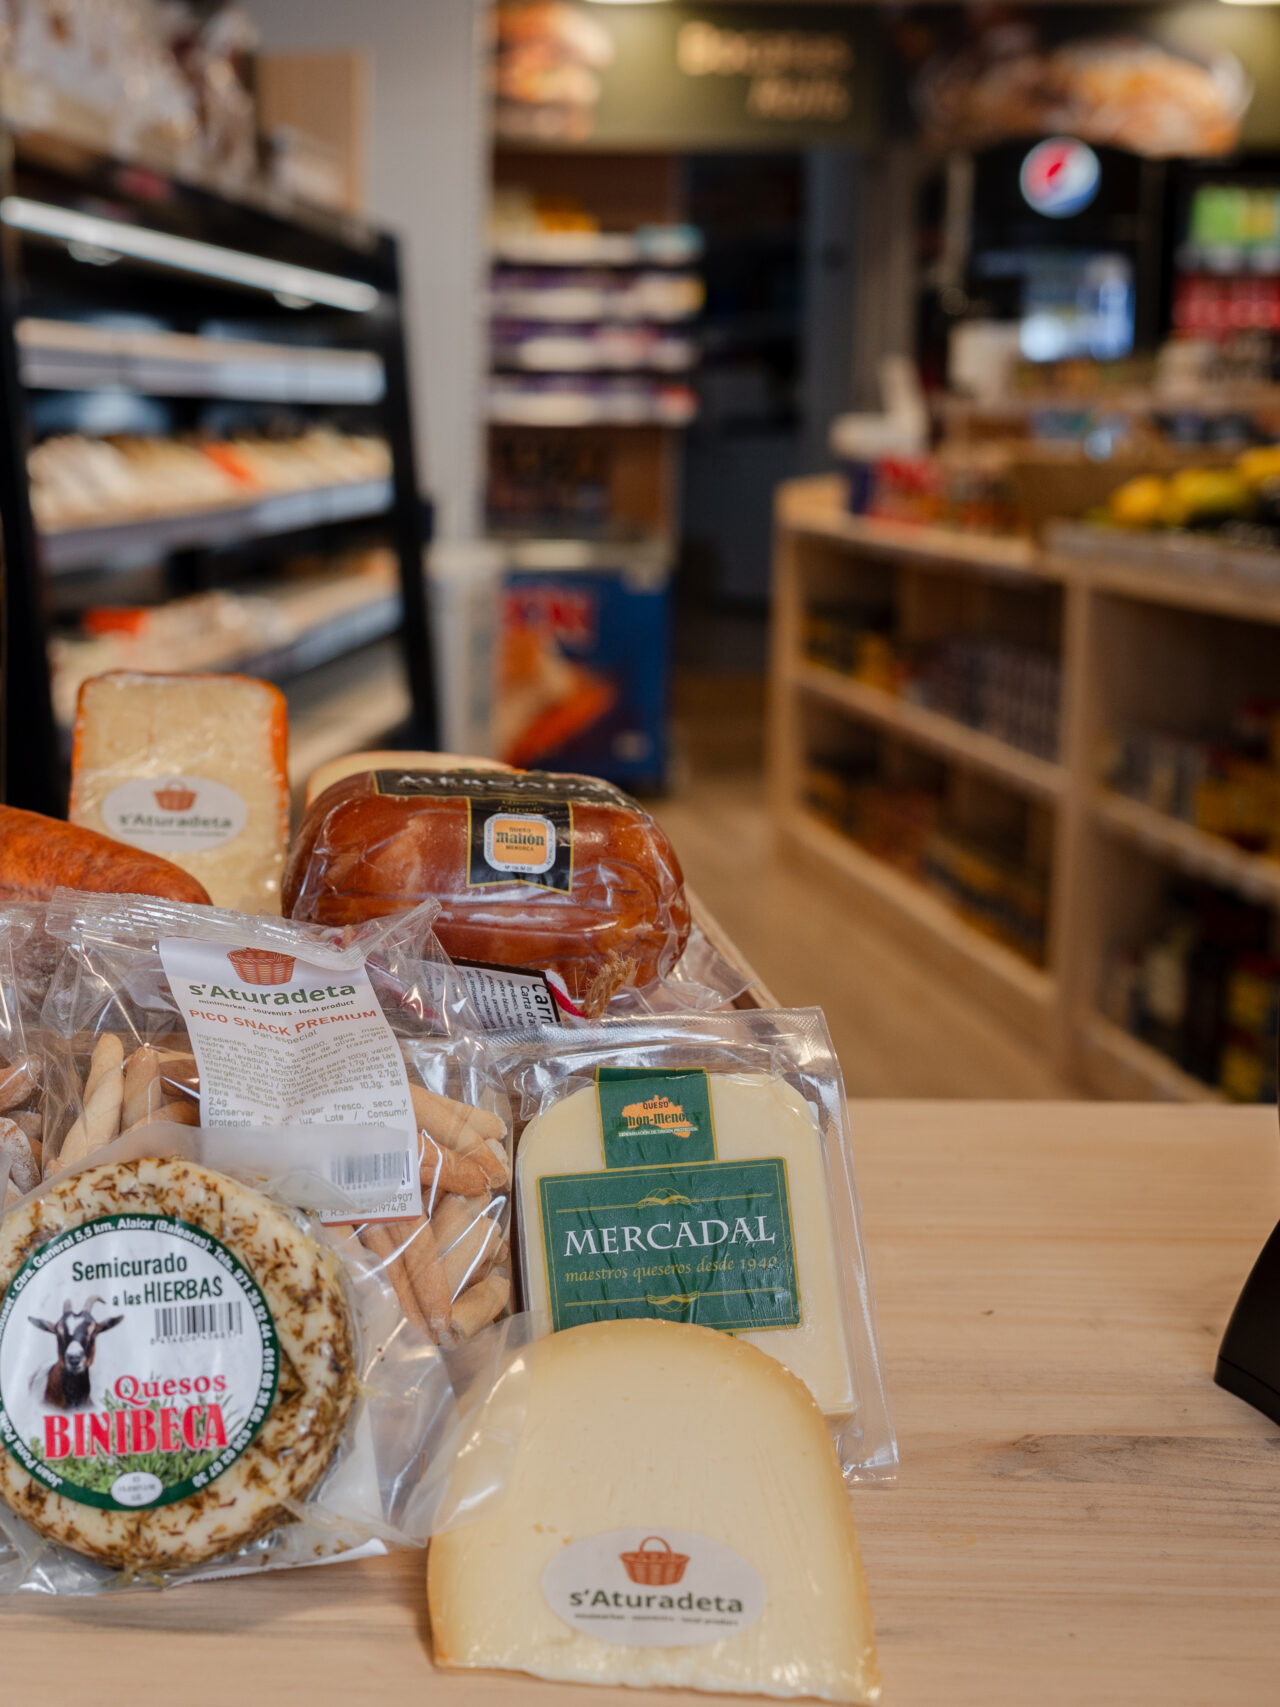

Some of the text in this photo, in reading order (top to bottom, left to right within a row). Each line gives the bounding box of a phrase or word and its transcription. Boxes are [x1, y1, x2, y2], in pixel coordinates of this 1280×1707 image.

[496, 831, 545, 847] mahón
[188, 983, 356, 1006] s'Aturadeta
[520, 985, 532, 1010] Carta
[252, 1006, 293, 1017] souvenirs
[298, 1005, 320, 1016] local
[321, 999, 355, 1012] product
[188, 1009, 378, 1037] PICO SNACK PREMIUM
[252, 1029, 318, 1045] Pan especial
[642, 1101, 669, 1110] QUESO
[74, 1226, 93, 1242] 5,5
[93, 1221, 116, 1234] km.
[117, 1217, 153, 1230] Alaior
[563, 1215, 775, 1258] MERCADAL
[32, 1236, 75, 1269] General
[71, 1252, 188, 1283] Semicurado
[233, 1268, 252, 1290] 971
[565, 1253, 779, 1284] maestros queseros desde 1940
[112, 1275, 223, 1306] a las HIERBAS
[260, 1322, 273, 1340] 44
[114, 1374, 227, 1406] Quesos
[42, 1402, 228, 1460] BINIBECA
[12, 1440, 38, 1470] Pons
[35, 1464, 64, 1488] Joan
[569, 1589, 744, 1614] s'Aturadeta
